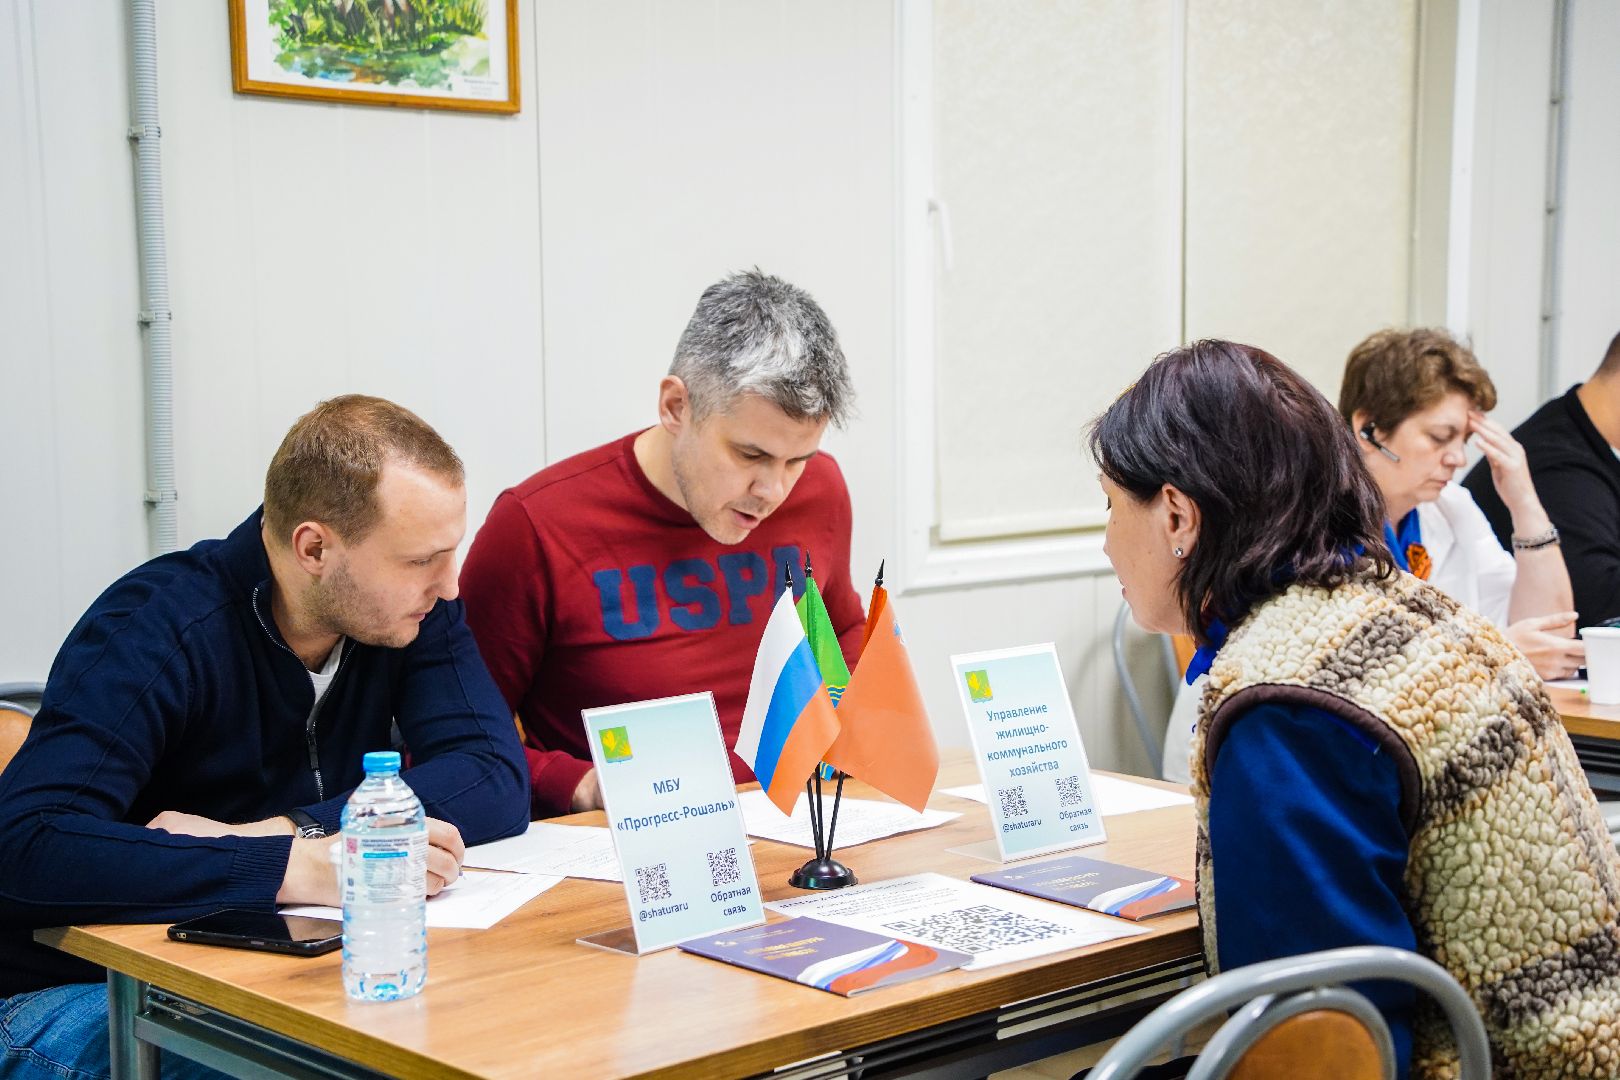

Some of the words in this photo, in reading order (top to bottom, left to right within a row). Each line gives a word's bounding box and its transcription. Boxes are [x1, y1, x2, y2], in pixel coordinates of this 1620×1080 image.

[986, 704, 1047, 722] Управление
[995, 724, 1049, 740] жилищно-
[987, 739, 1068, 761] коммунального
[1009, 761, 1059, 777] хозяйства
[653, 778, 680, 794] МБУ
[617, 800, 734, 831] «Прогресс-Рошаль»
[1059, 808, 1092, 821] Обратная
[1002, 818, 1042, 833] @shaturaru
[1069, 822, 1089, 832] связь
[710, 886, 752, 904] Обратная
[639, 900, 689, 922] @shaturaru
[723, 904, 747, 917] связь
